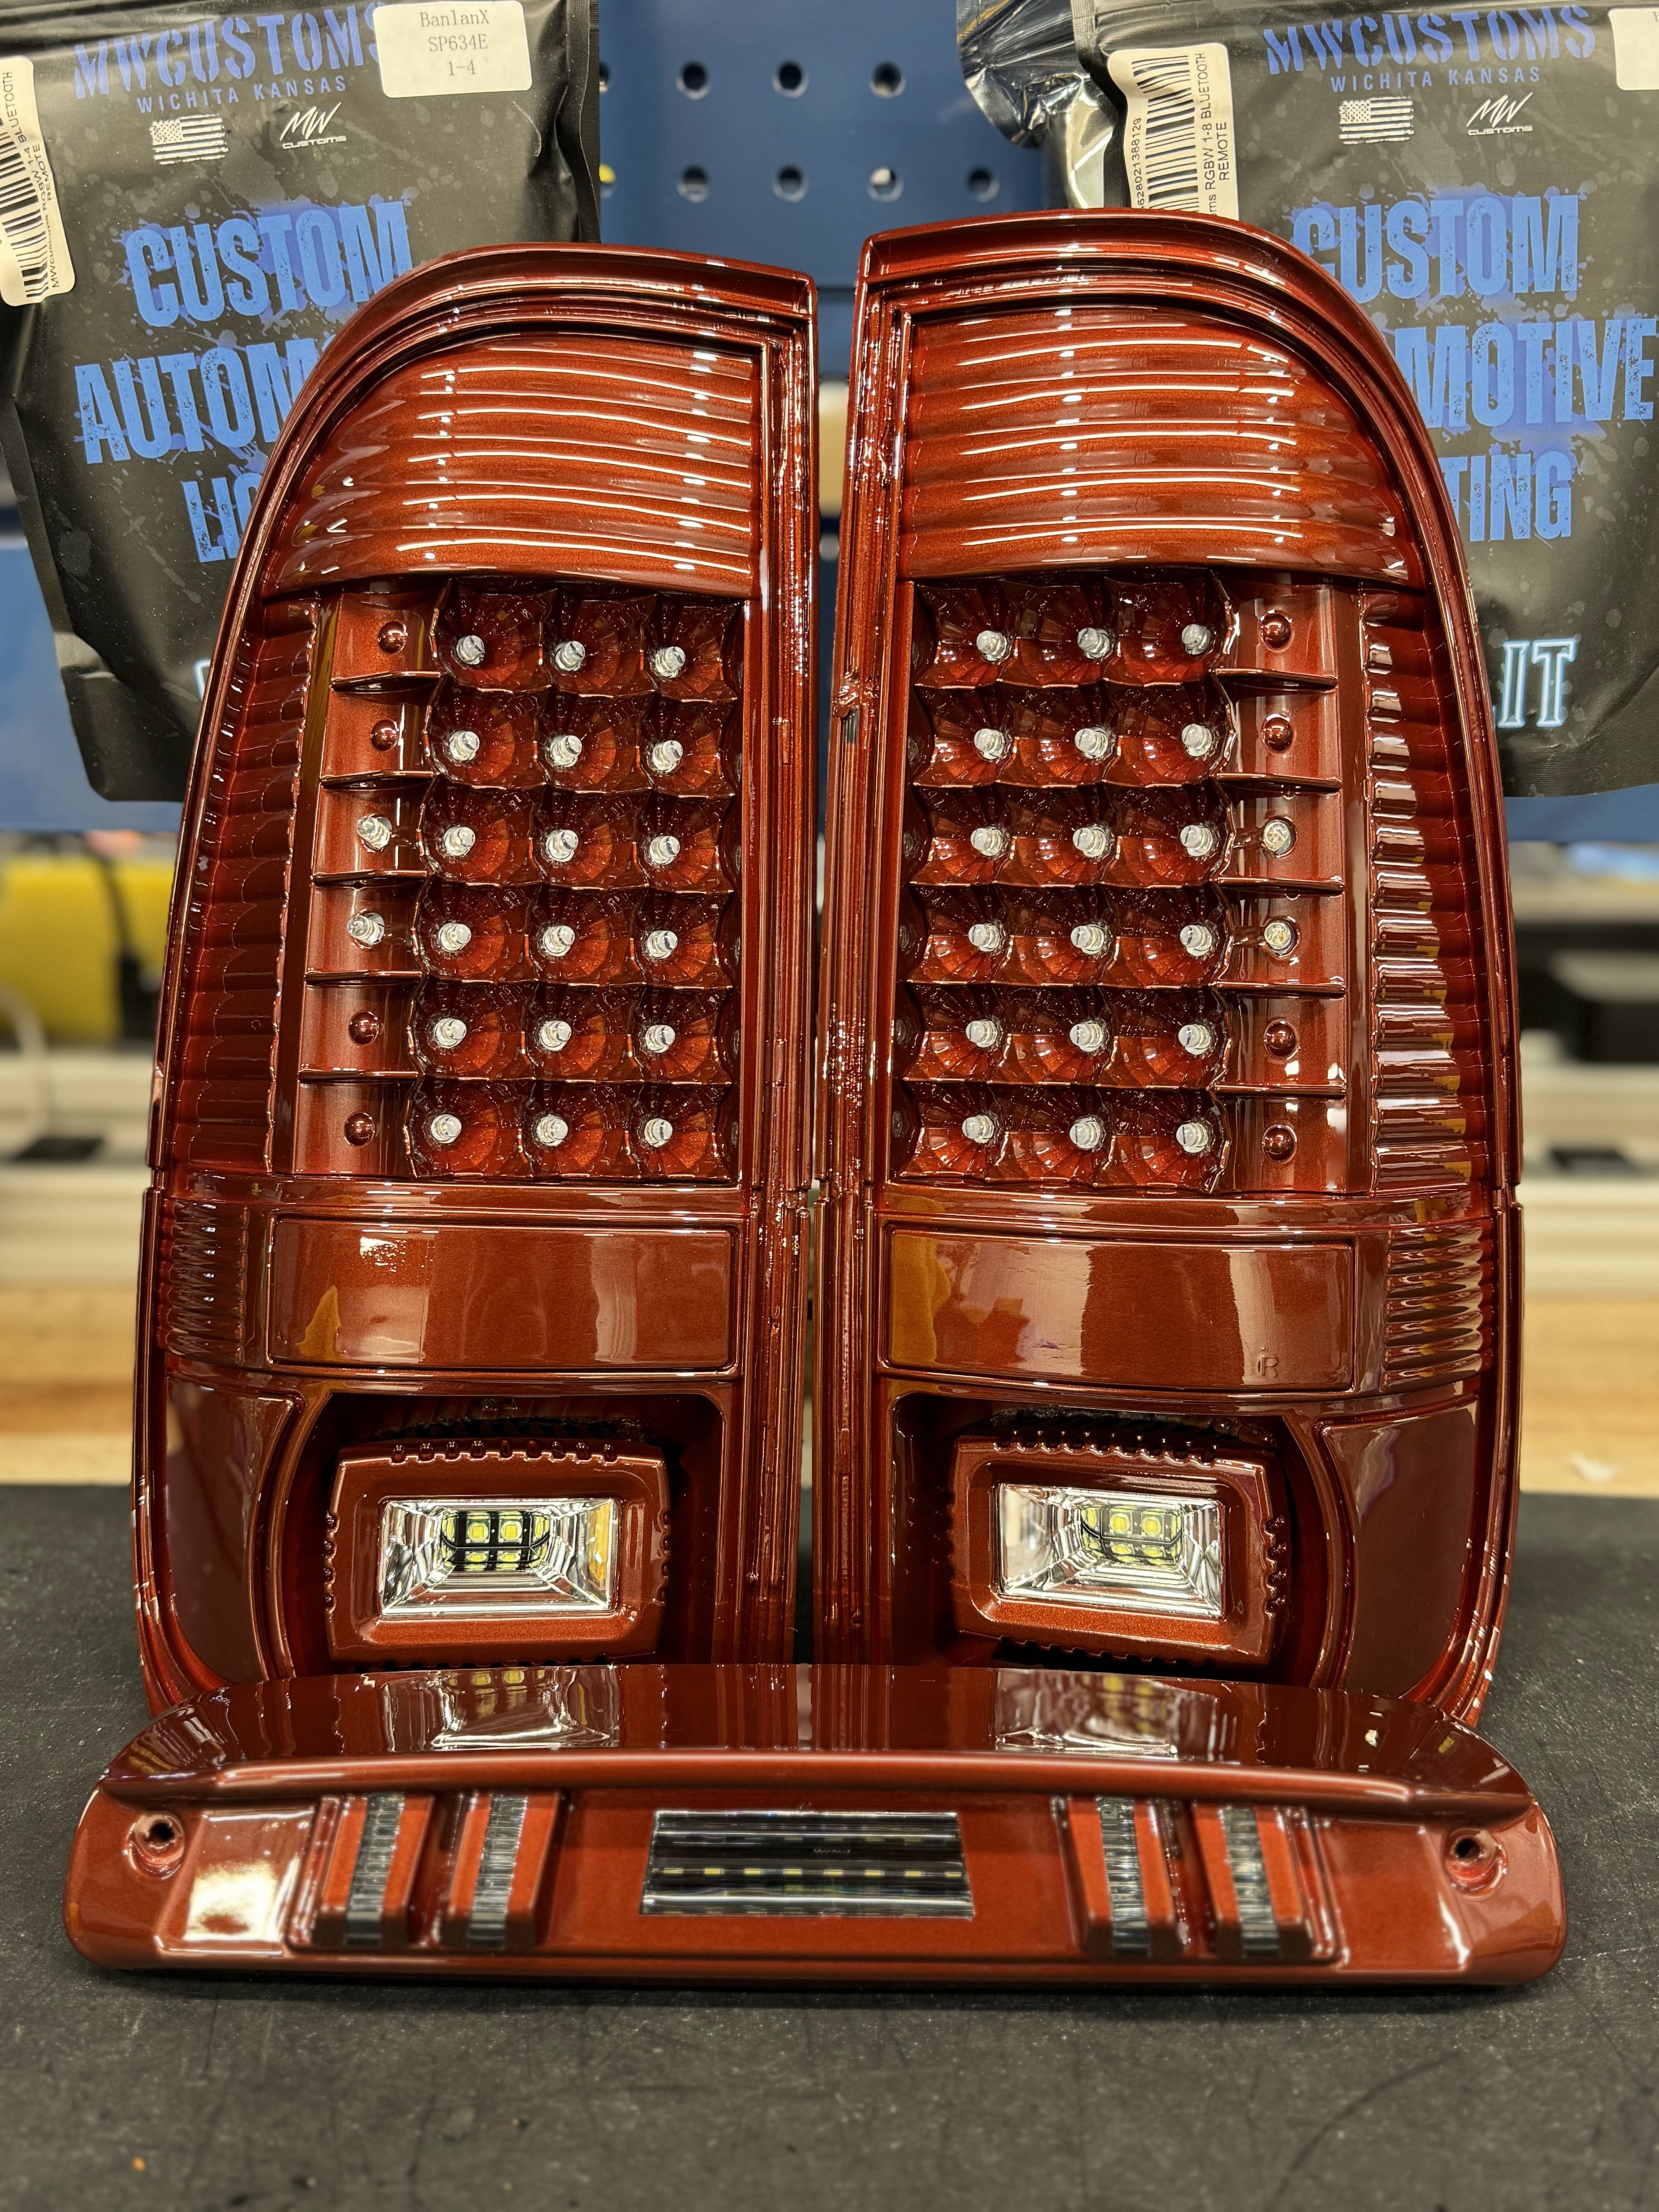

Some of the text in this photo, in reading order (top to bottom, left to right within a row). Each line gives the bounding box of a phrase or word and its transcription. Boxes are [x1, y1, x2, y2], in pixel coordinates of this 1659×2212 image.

[420, 10, 489, 27] BanlanX
[428, 34, 488, 52] SP634E
[1264, 5, 1595, 75] MWCUSTOMS
[448, 60, 476, 76] 1-4
[1195, 53, 1212, 119] BLUETOOTH
[1331, 66, 1540, 92] WICHITA KANSAS
[2, 71, 27, 143] BLUETOOTH
[137, 75, 346, 114] WICHITA KANSAS
[24, 147, 34, 165] 1-4
[1201, 123, 1212, 143] 1-8
[1216, 122, 1230, 181] REMOTE
[32, 143, 52, 200] REMOTE
[1131, 118, 1145, 210] 628021388129
[1202, 148, 1216, 190] RGBW
[32, 170, 47, 211] RGBW
[126, 201, 413, 327] CUSTOM
[74, 334, 336, 464] AUTOM
[1493, 638, 1576, 729] IT
